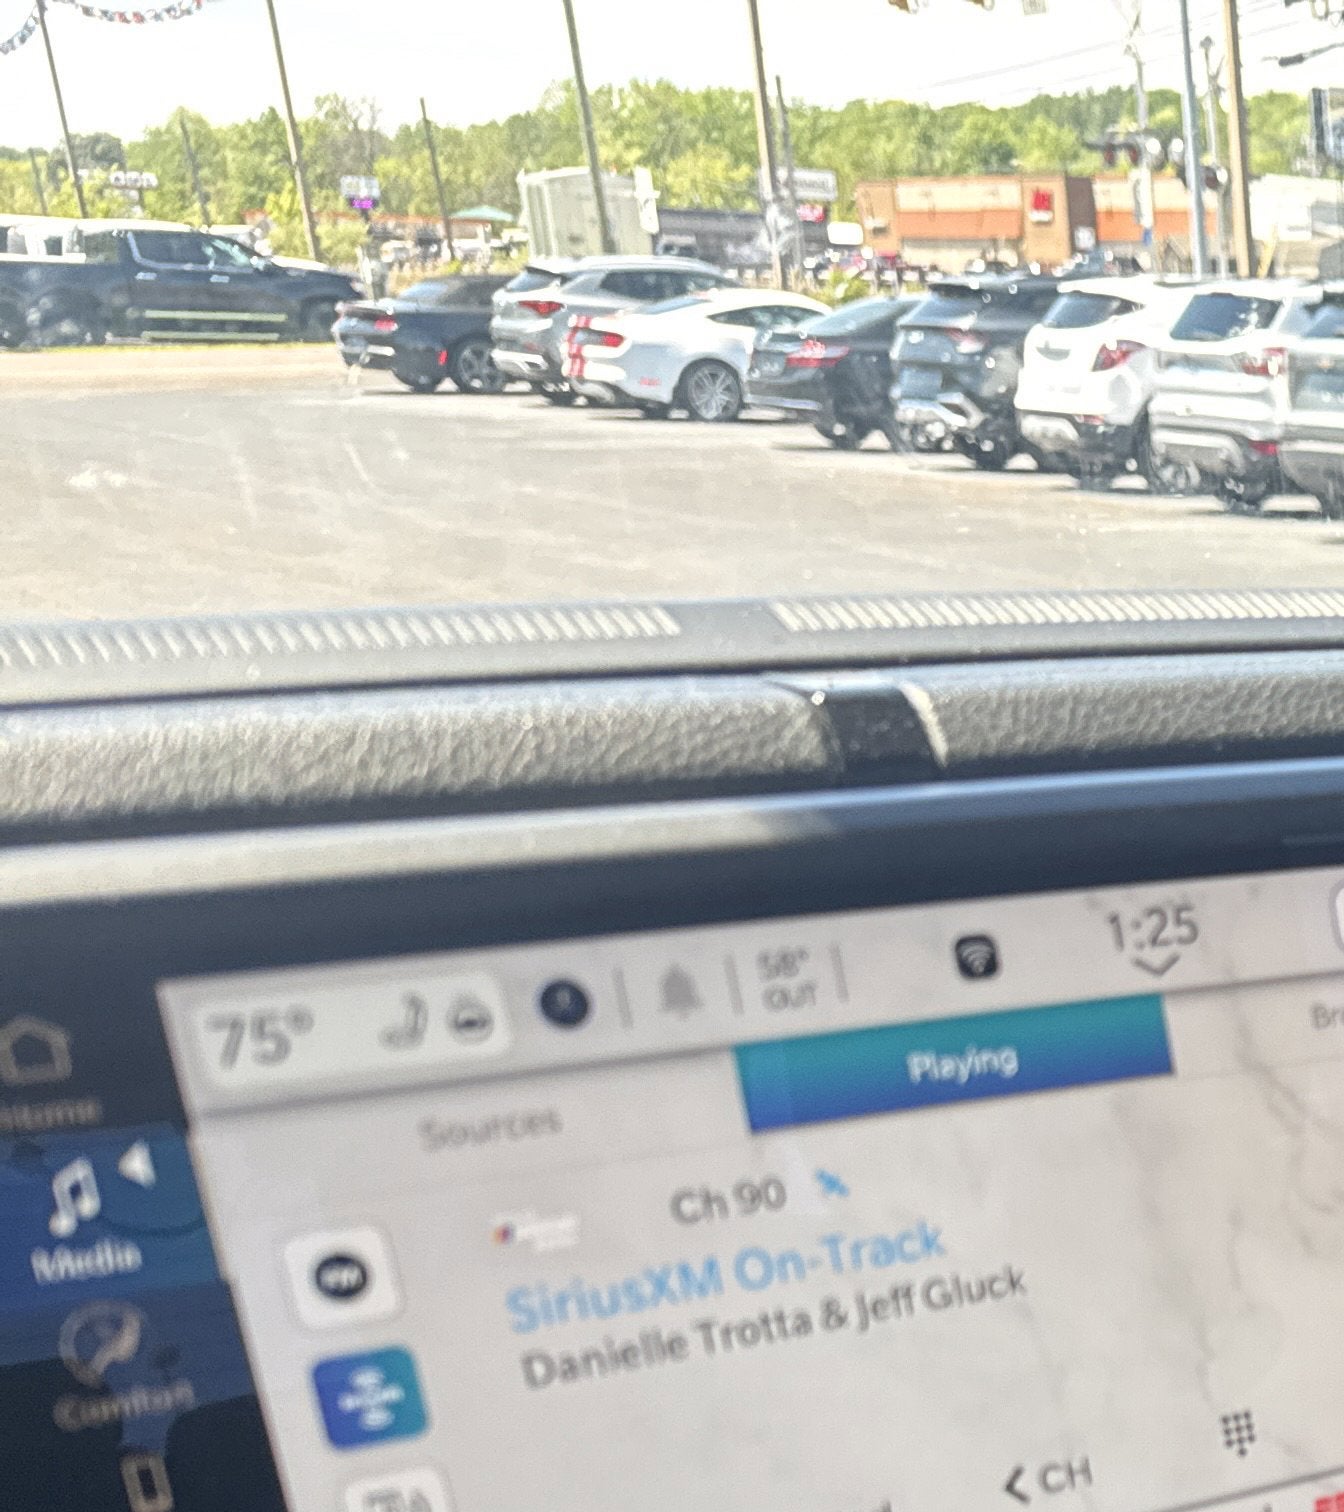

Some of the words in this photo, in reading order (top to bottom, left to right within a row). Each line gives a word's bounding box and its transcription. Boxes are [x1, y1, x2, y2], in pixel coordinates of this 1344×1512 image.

[1108, 903, 1200, 953] 1:25
[761, 977, 816, 1013] OUT
[907, 1045, 1020, 1085] Playing
[419, 1107, 563, 1151] Sources
[669, 1185, 729, 1226] Ch
[732, 1175, 788, 1216] 90
[30, 1238, 142, 1285] Media
[505, 1256, 725, 1335] SiriusXM
[733, 1220, 946, 1292] On-Track
[520, 1325, 690, 1391] Danielle
[692, 1307, 815, 1355] Trotta
[819, 1295, 849, 1333] &
[856, 1287, 917, 1335] Jeff
[920, 1264, 1027, 1314] Gluck
[1038, 1457, 1095, 1495] CH
